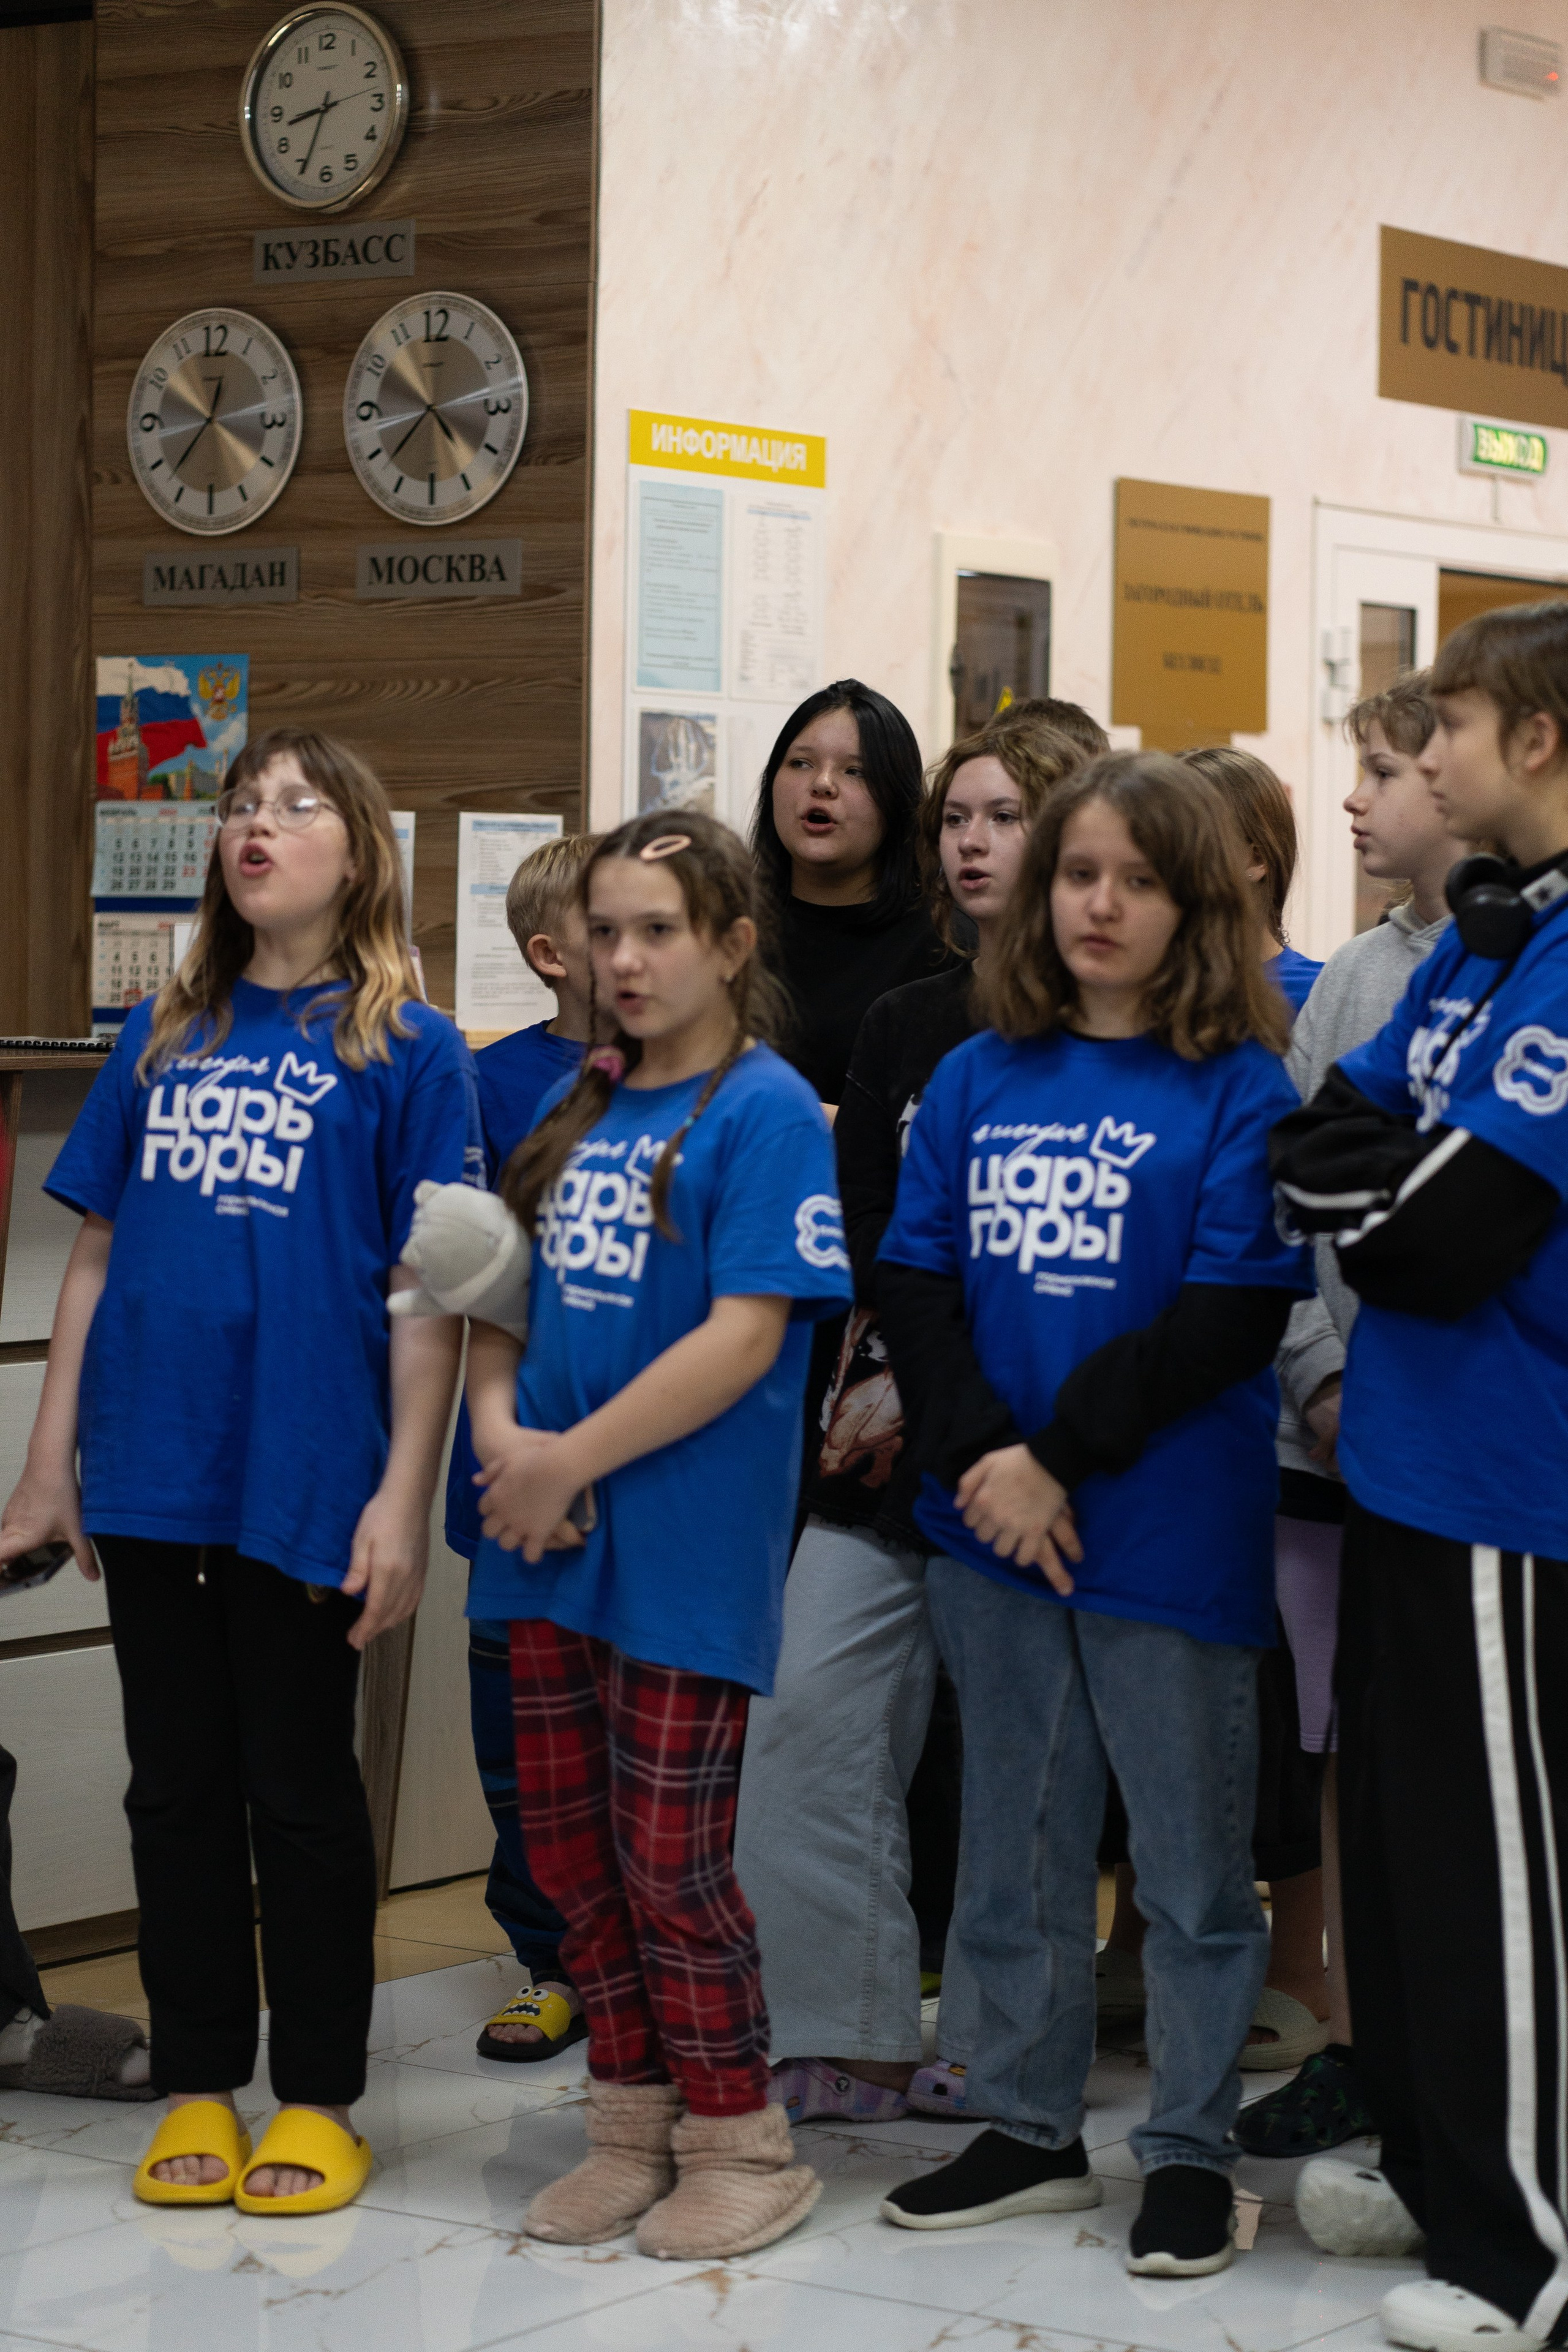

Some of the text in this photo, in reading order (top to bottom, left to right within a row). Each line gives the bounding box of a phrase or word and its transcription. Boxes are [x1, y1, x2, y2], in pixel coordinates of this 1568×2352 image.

[318, 33, 336, 50] 12
[298, 47, 309, 64] 11
[364, 61, 377, 78] 2
[279, 72, 293, 89] 10
[371, 93, 385, 112] 3
[271, 105, 284, 123] 9
[364, 125, 377, 141] 4
[277, 137, 290, 154] 8
[296, 159, 307, 175] 7
[344, 154, 358, 171] 5
[320, 166, 333, 183] 6
[262, 233, 405, 271] КУЗБАСС
[391, 323, 411, 347] 11
[423, 309, 450, 342] 12
[173, 338, 192, 361] 11
[203, 325, 228, 357] 12
[367, 353, 385, 377] 10
[484, 353, 502, 371] 2
[149, 368, 168, 390] 10
[261, 369, 277, 385] 2
[356, 401, 383, 421] 9
[483, 398, 511, 416] 3
[139, 413, 164, 432] 9
[260, 410, 287, 429] 3
[651, 422, 807, 473] ИНФОРМАЦИЯ
[152, 560, 287, 592] МАГАДАН
[368, 554, 507, 586] МОСКВА
